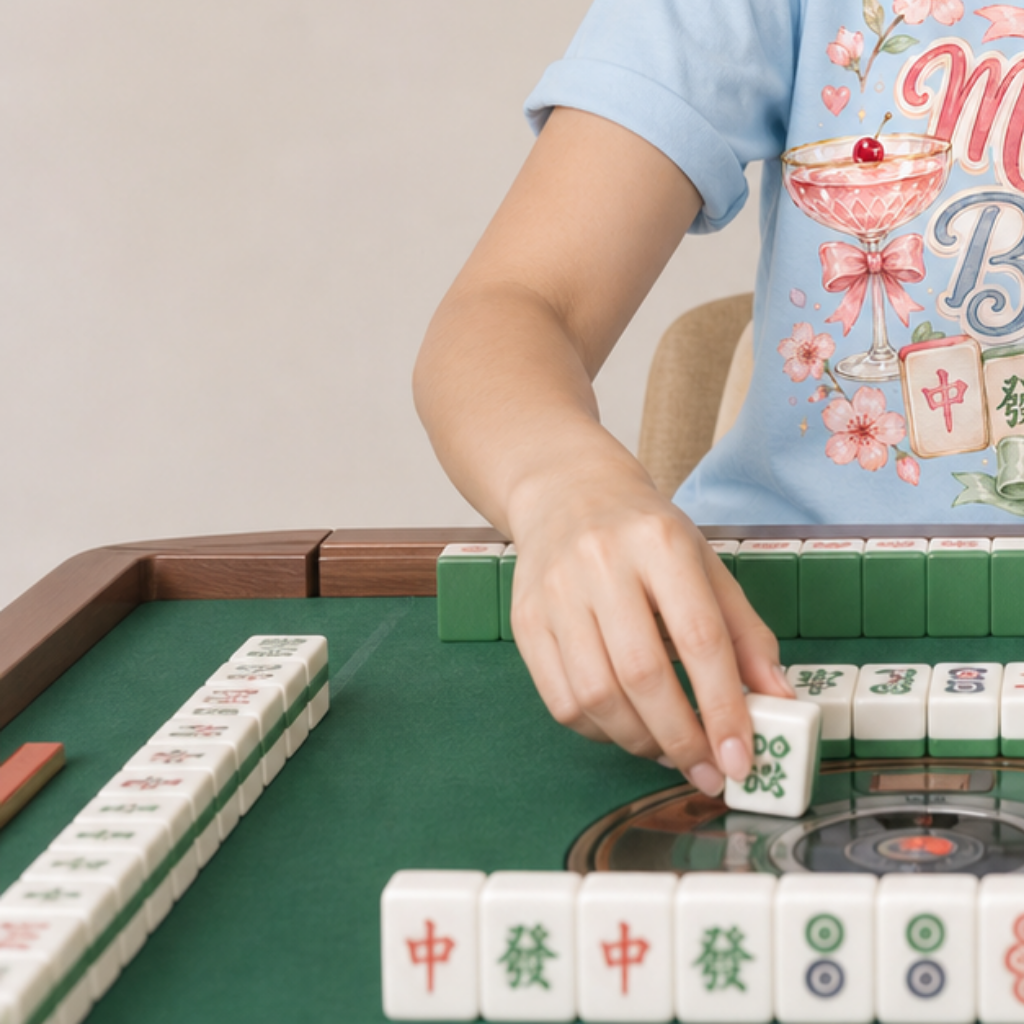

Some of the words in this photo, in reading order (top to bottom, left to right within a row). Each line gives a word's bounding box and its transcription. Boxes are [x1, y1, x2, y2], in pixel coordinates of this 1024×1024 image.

[921, 368, 968, 434] 中
[405, 919, 456, 994] 中
[499, 923, 560, 990] 發
[600, 921, 651, 996] 中
[694, 925, 755, 992] 發
